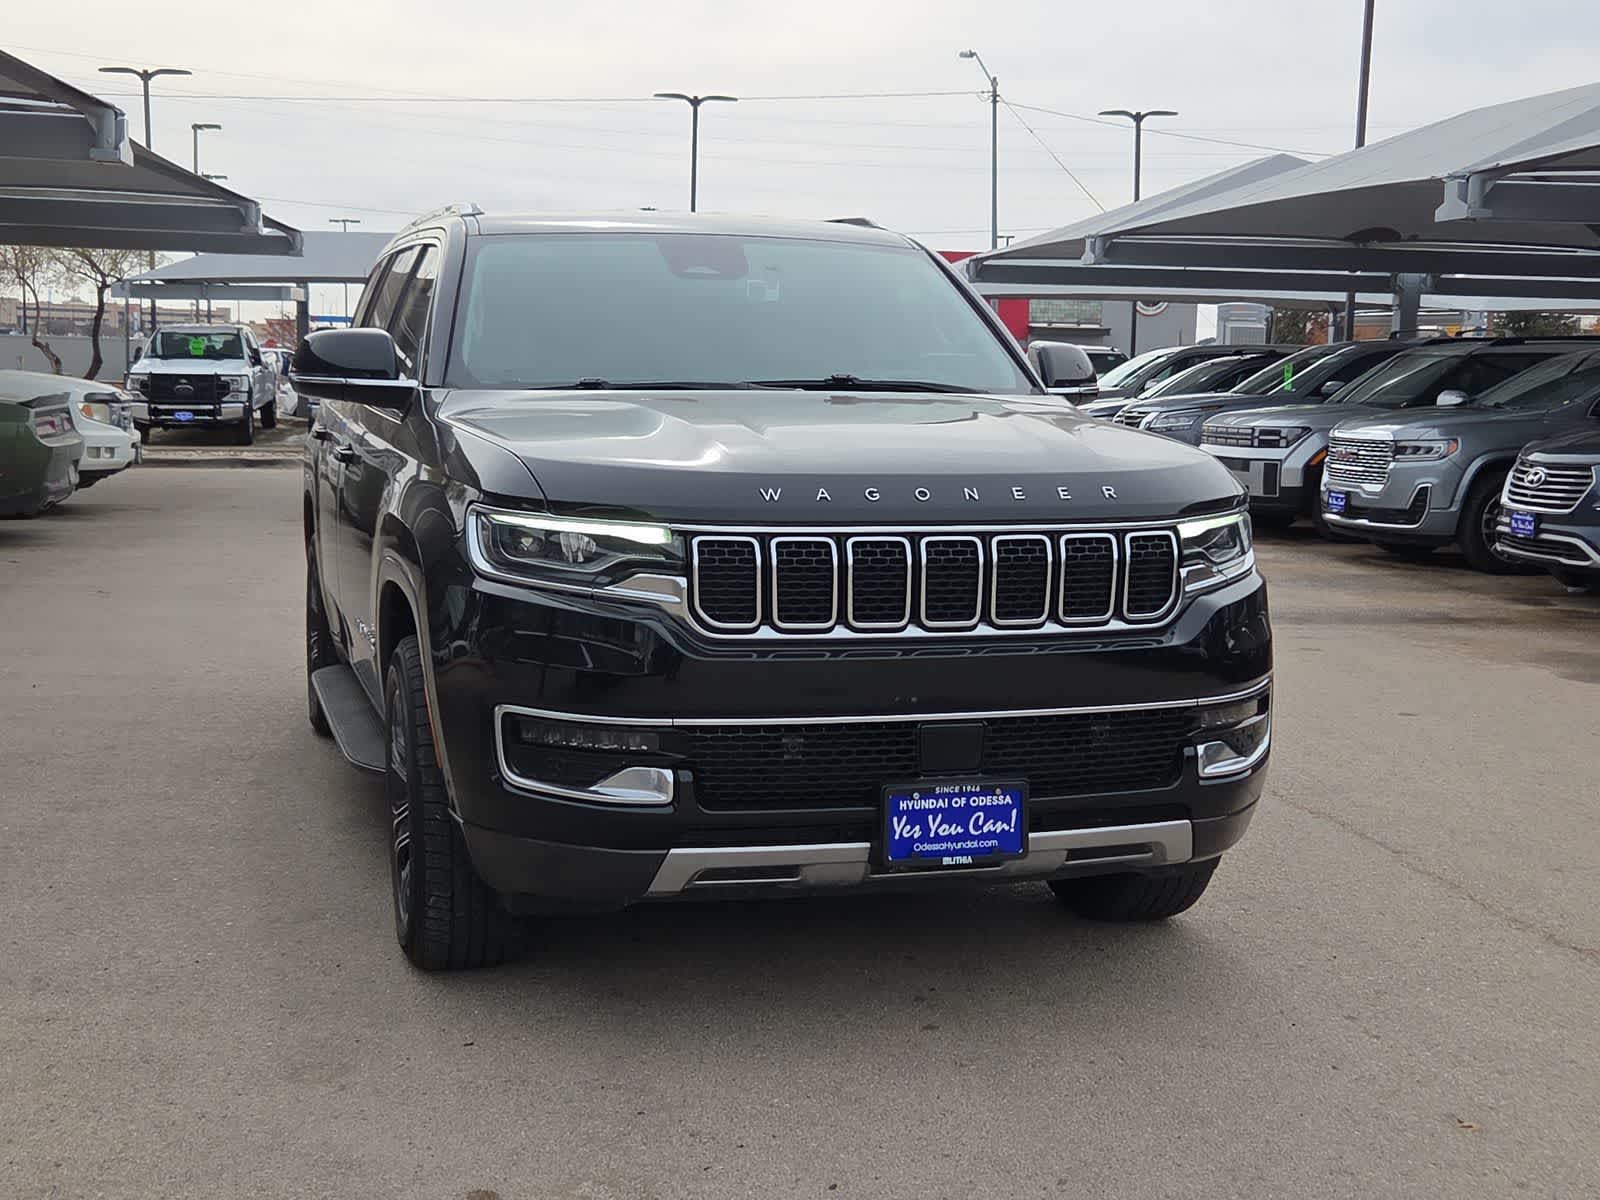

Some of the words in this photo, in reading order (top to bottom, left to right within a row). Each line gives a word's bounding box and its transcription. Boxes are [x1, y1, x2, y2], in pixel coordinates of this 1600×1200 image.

[759, 485, 1118, 501] WAGONEER
[935, 786, 960, 794] SINCE
[899, 798, 948, 810] HYUNDAI
[951, 797, 967, 808] OF
[969, 795, 1012, 807] ODESSA
[892, 815, 922, 840] Yes
[928, 813, 964, 838] You
[968, 808, 1018, 836] Can!
[913, 839, 999, 852] OdessaHyundai.com
